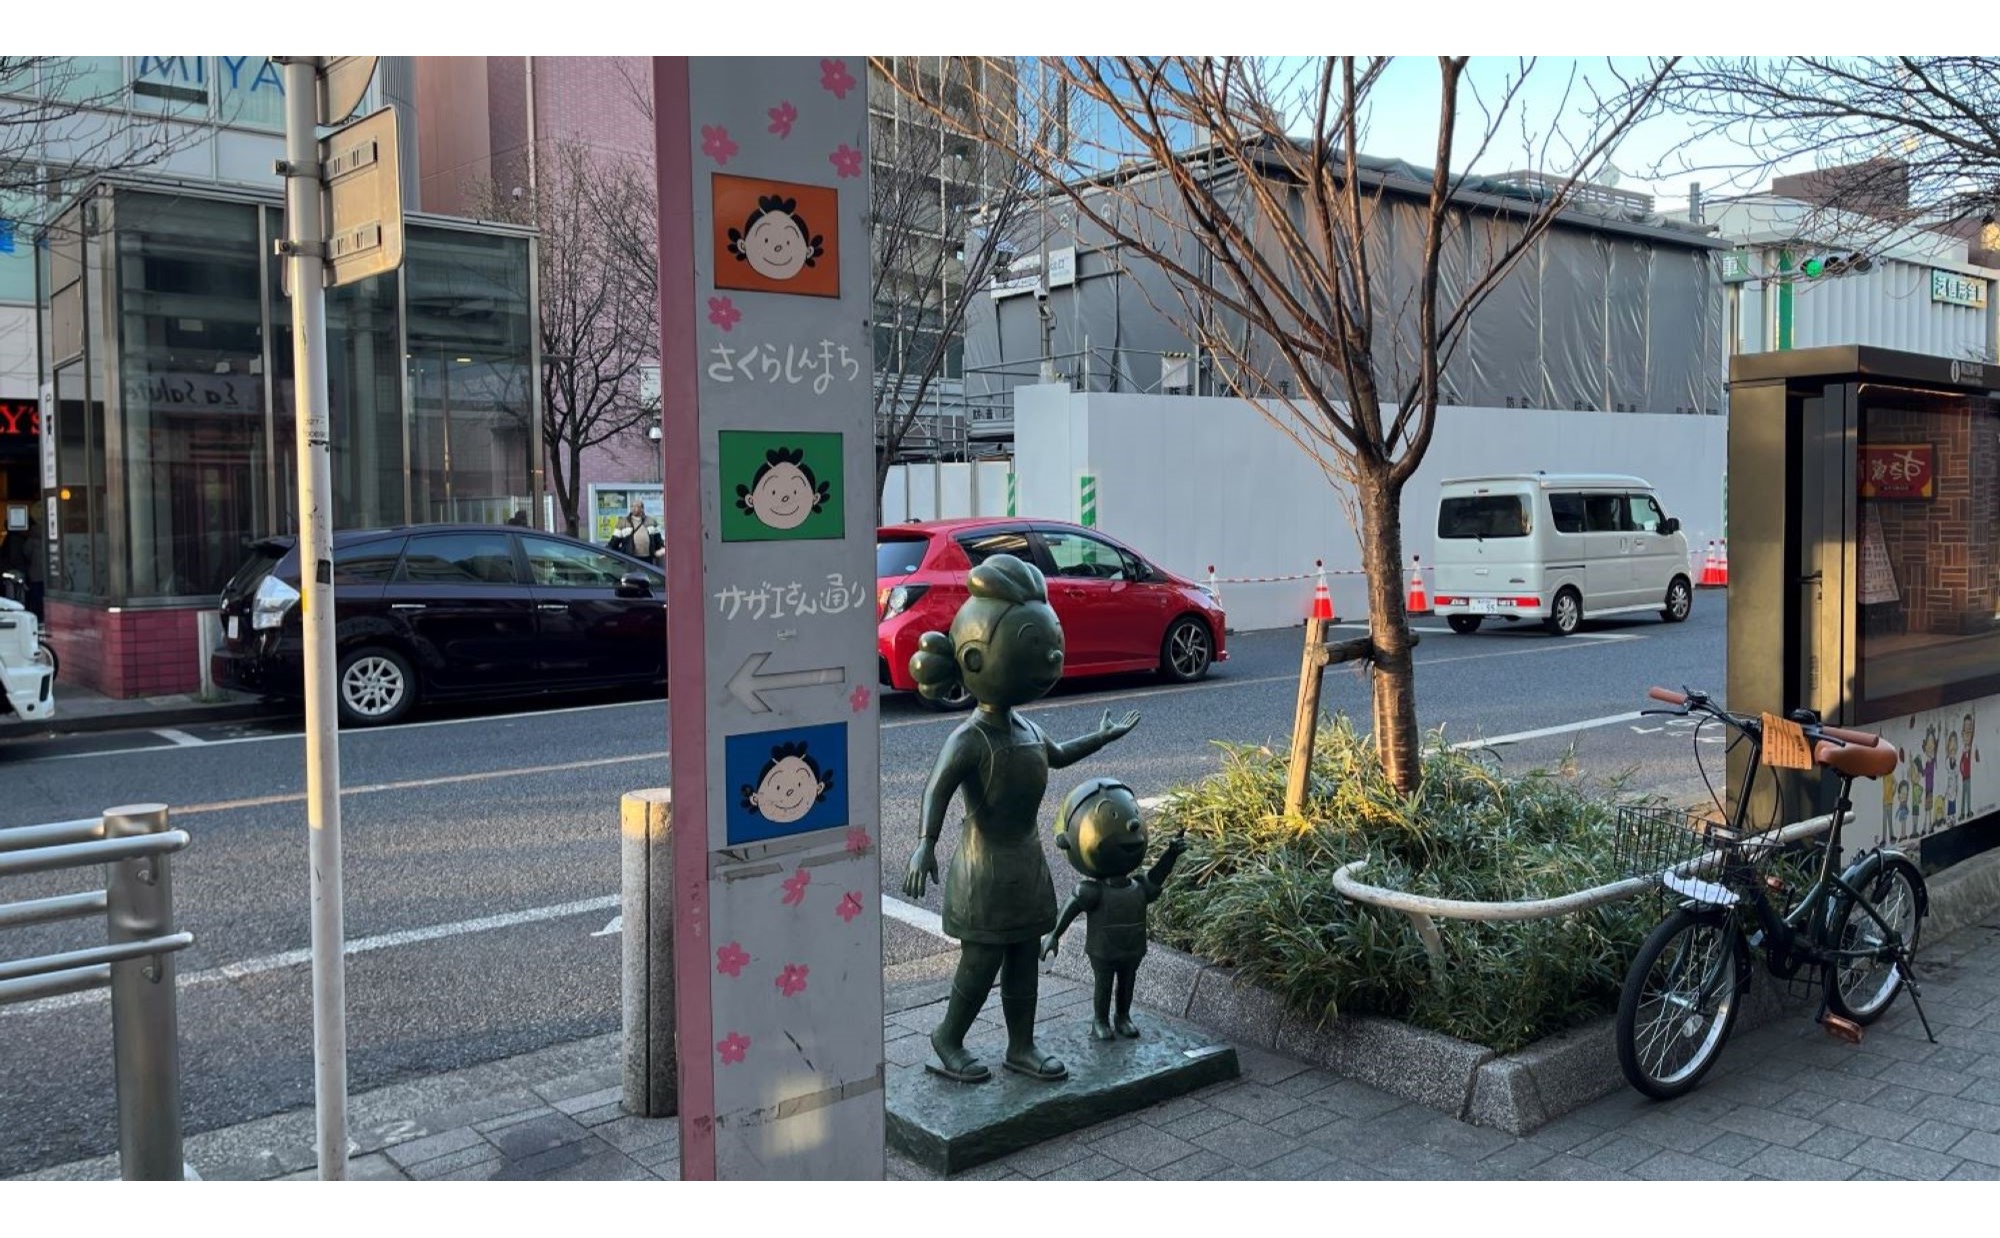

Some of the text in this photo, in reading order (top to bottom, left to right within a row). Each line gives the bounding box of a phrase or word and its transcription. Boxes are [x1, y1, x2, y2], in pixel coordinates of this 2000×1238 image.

[707, 338, 860, 395] さくらしんまち
[0, 405, 40, 434] Y's
[713, 572, 866, 621] サザエさん通り
